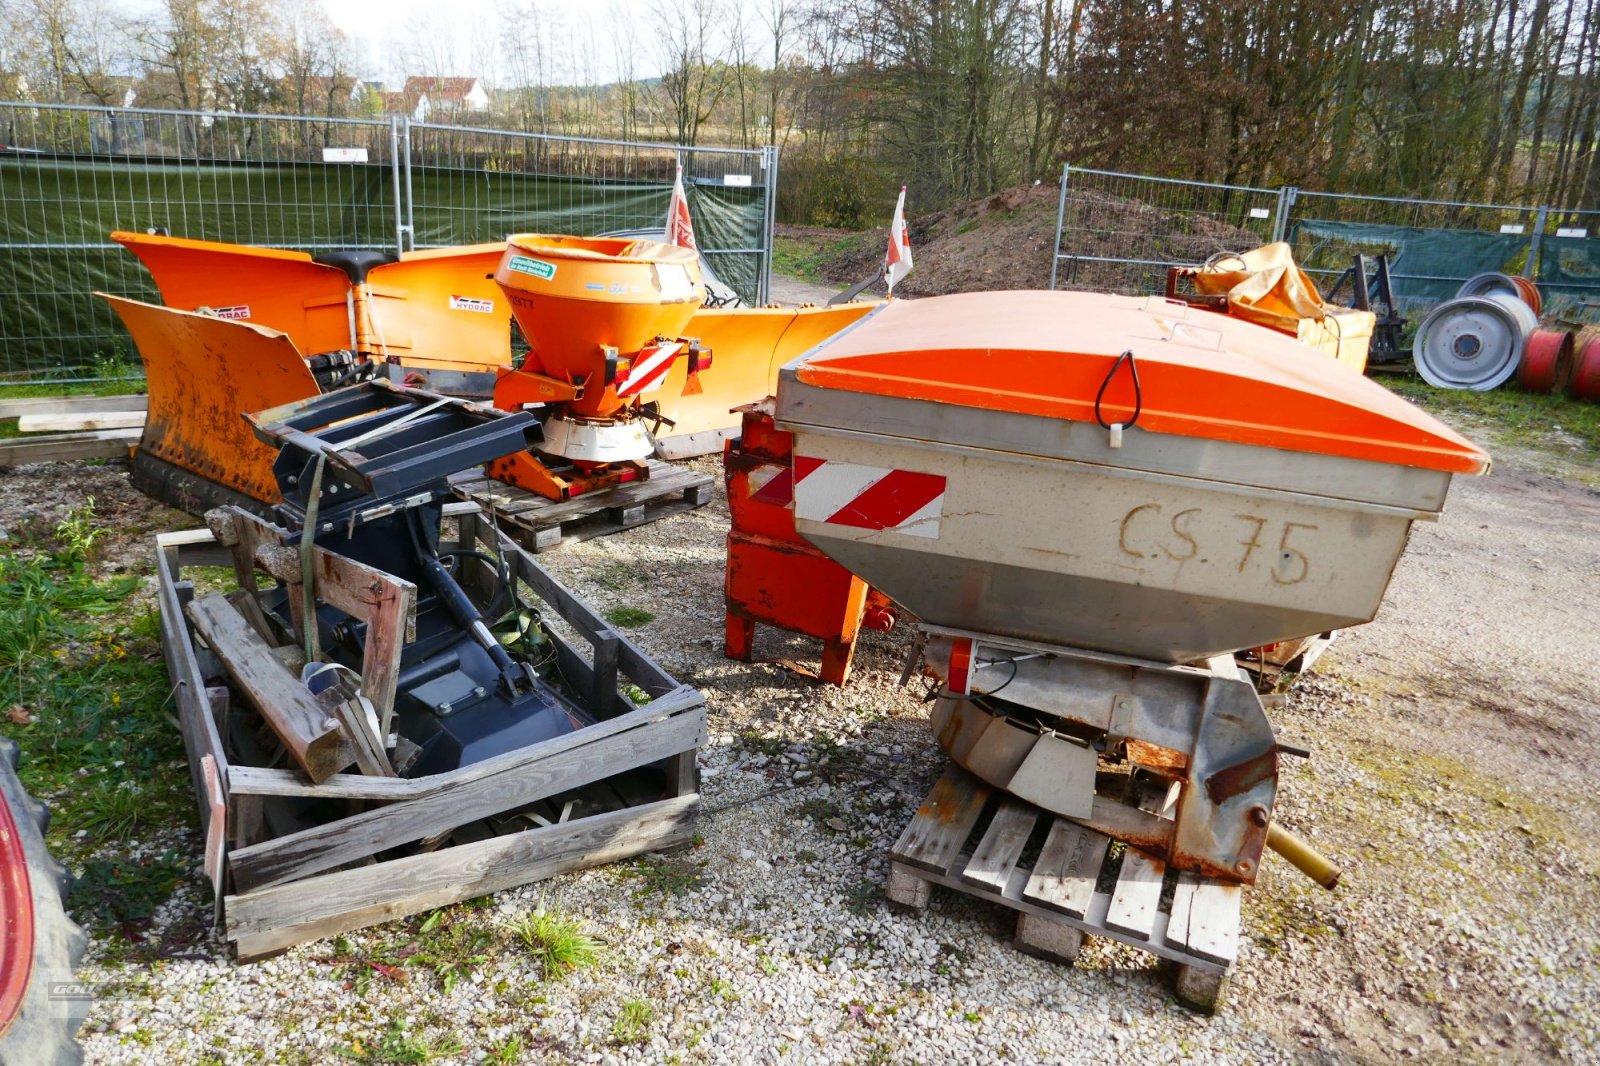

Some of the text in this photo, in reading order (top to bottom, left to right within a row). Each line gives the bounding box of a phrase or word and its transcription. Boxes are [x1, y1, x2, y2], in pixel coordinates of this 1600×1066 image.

[456, 302, 491, 312] HYDRAC
[218, 311, 249, 319] DRAC
[1233, 514, 1318, 585] 75
